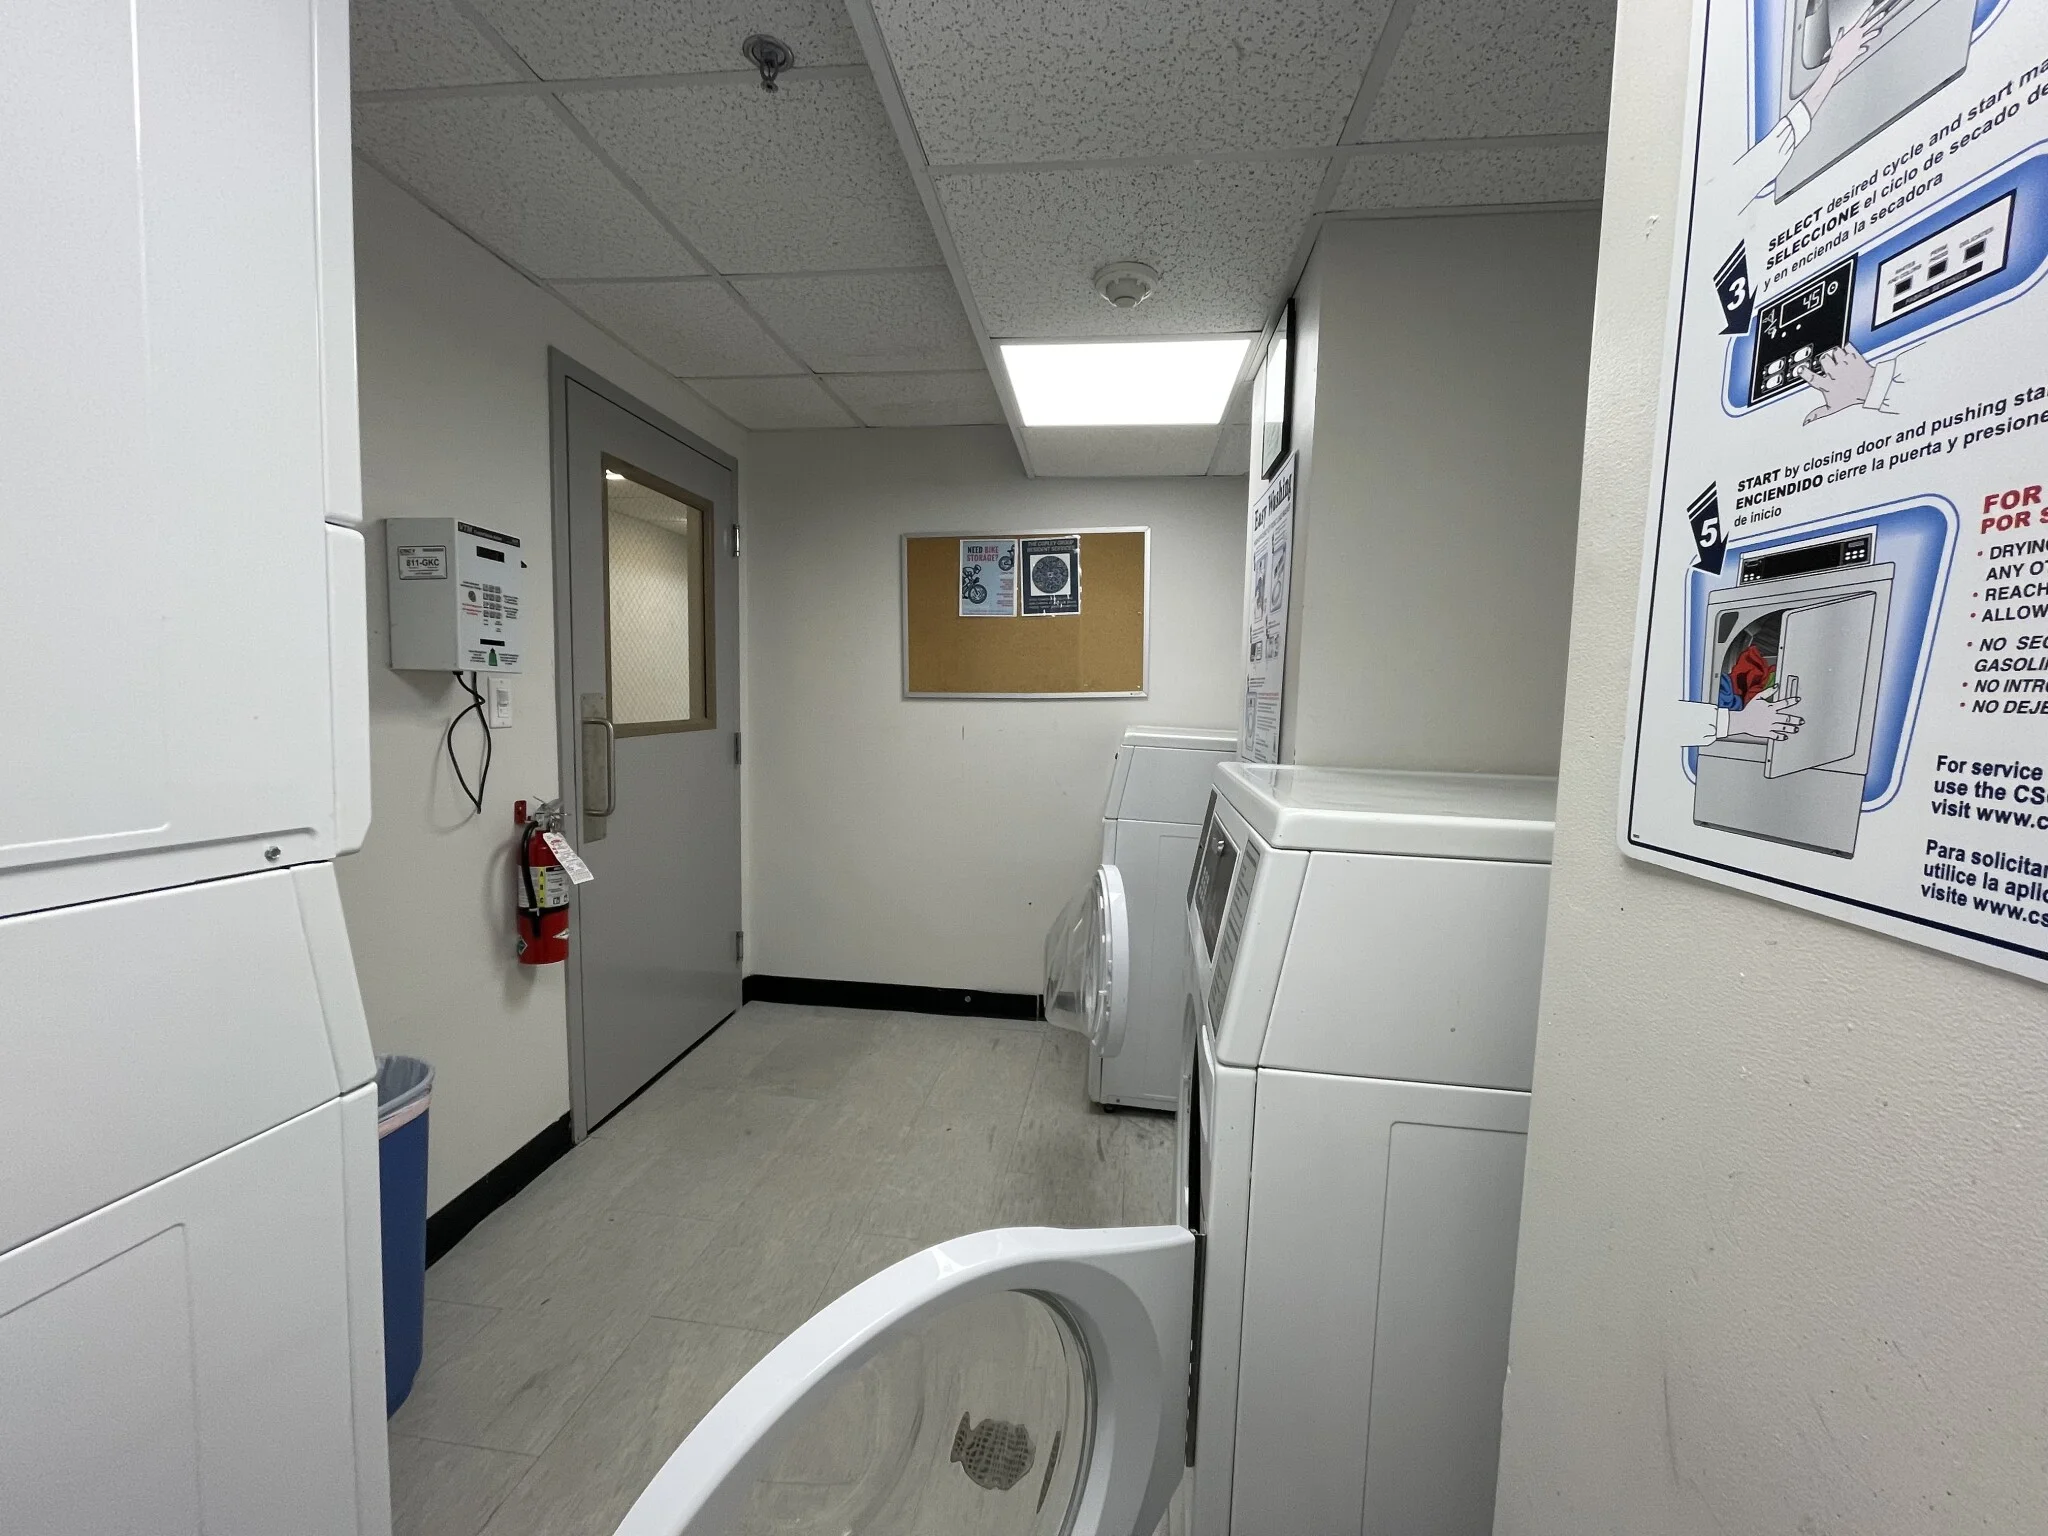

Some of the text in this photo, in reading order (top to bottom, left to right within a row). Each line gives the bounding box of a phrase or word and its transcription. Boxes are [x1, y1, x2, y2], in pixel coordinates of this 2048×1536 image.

[1768, 206, 1823, 251] SELECT
[1827, 170, 1879, 214] desired
[1882, 142, 1924, 178] cycle
[1928, 112, 1963, 147] and
[1966, 80, 2015, 121] start
[1765, 201, 1860, 270] SELECCIONE
[1863, 190, 1878, 209] el
[1881, 167, 1919, 198] ciclo
[1923, 150, 1945, 171] de
[1949, 103, 2021, 155] secado
[1763, 172, 1944, 292] y en encienda la secadora
[1726, 276, 1746, 311] 3
[1802, 288, 1821, 310] 45
[1737, 386, 2048, 493] START by closing door and pushing sta
[1735, 410, 2048, 510] ENCIENDIDO cierre la puerta y presione
[1254, 505, 1267, 531] Easy
[1268, 473, 1293, 514] Washing
[1983, 484, 2042, 514] FOR
[1734, 506, 1782, 527] de inicio
[1980, 511, 2031, 534] POR
[1699, 517, 1718, 548] 5
[966, 554, 999, 562] STORAGE?
[967, 545, 999, 554] NEED BIKE
[1990, 539, 2048, 560] DRYIN
[406, 558, 440, 567] 811-GKC
[1986, 562, 2024, 581] ANY
[1984, 582, 2048, 601] REACH
[1981, 604, 2048, 622] ALLOW
[1979, 637, 2007, 651] NO
[1974, 678, 2048, 693] NO INTR
[1972, 700, 1999, 713] NO
[1936, 755, 2043, 781] For service
[1934, 780, 2048, 805] use the CS
[1931, 798, 1971, 819] visit
[1926, 839, 1965, 862] Para
[1924, 863, 1977, 886] utilice
[1983, 872, 1999, 892] la
[1921, 883, 1968, 906] visite
